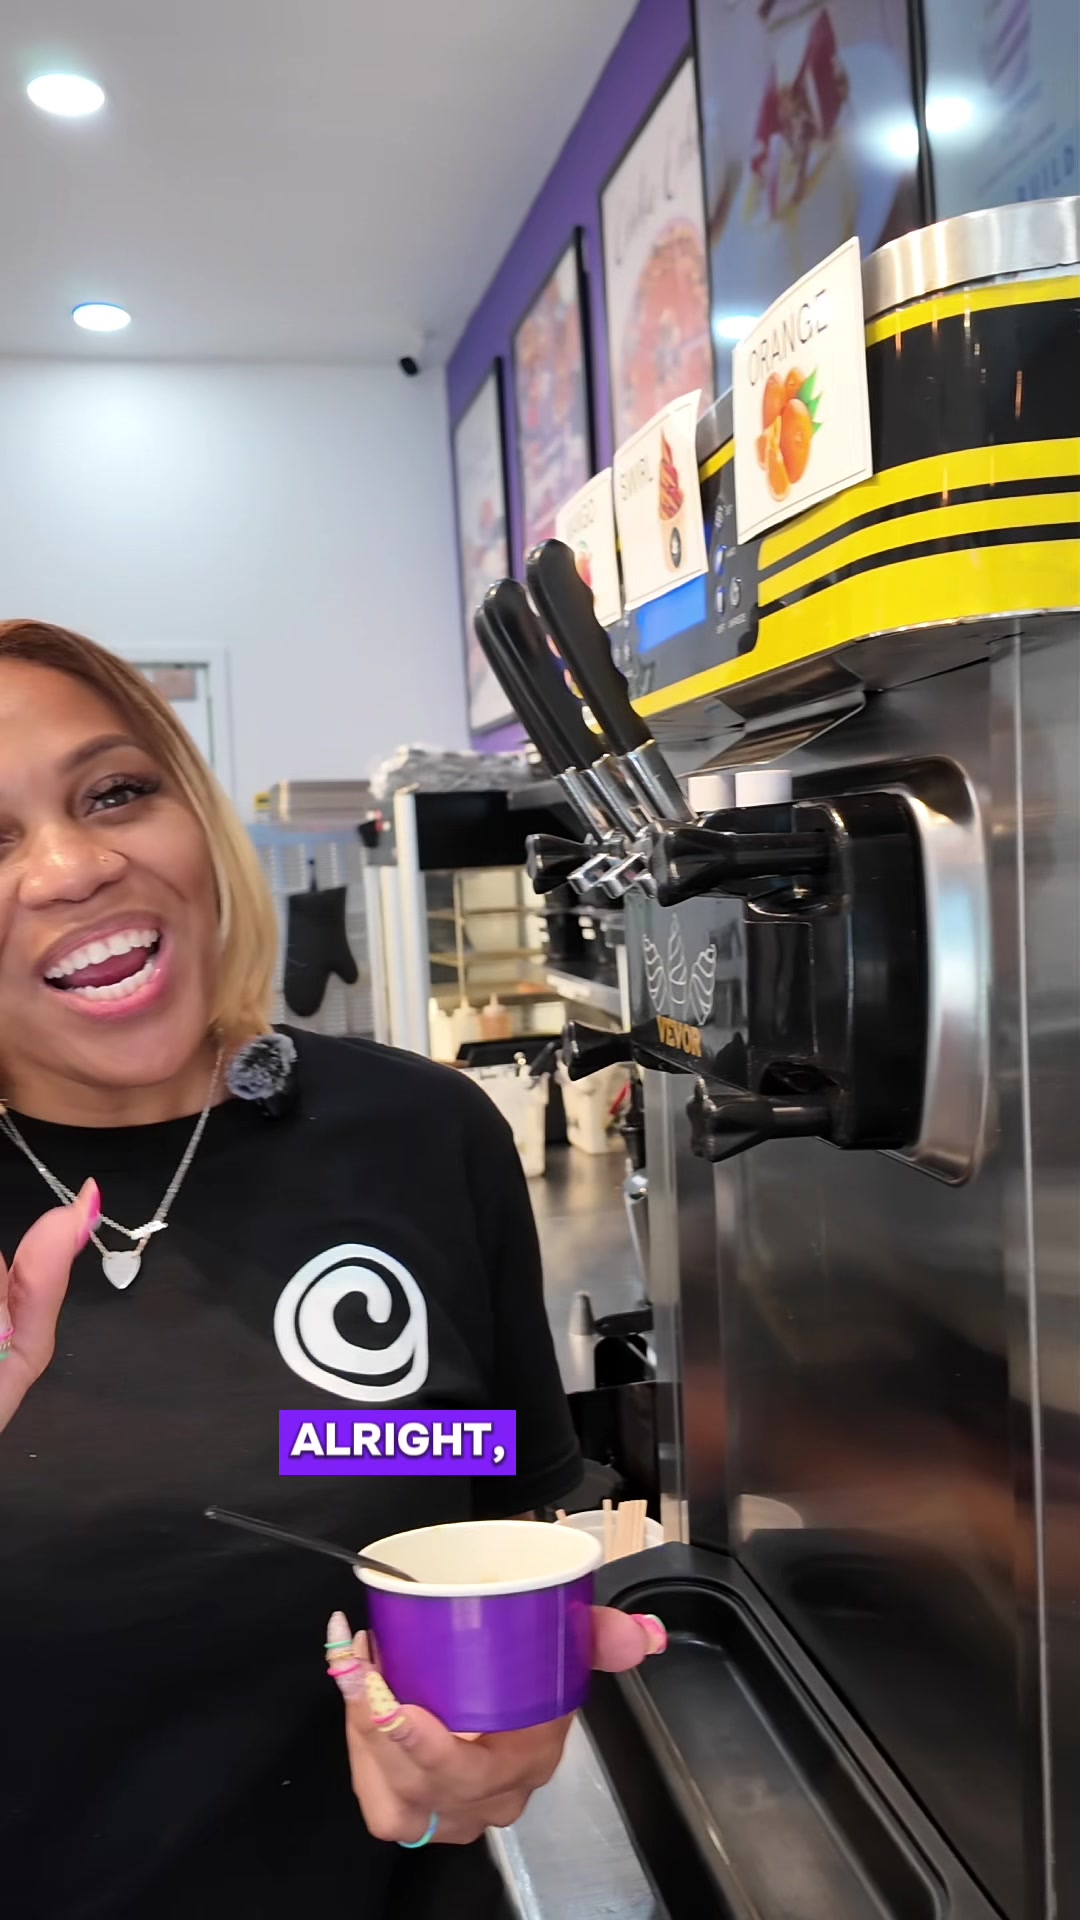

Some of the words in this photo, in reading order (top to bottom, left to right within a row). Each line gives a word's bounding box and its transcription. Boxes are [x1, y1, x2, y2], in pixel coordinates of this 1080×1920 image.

[748, 288, 828, 386] ORANGE
[620, 455, 654, 501] SWIRL
[656, 1015, 703, 1057] VEVOR
